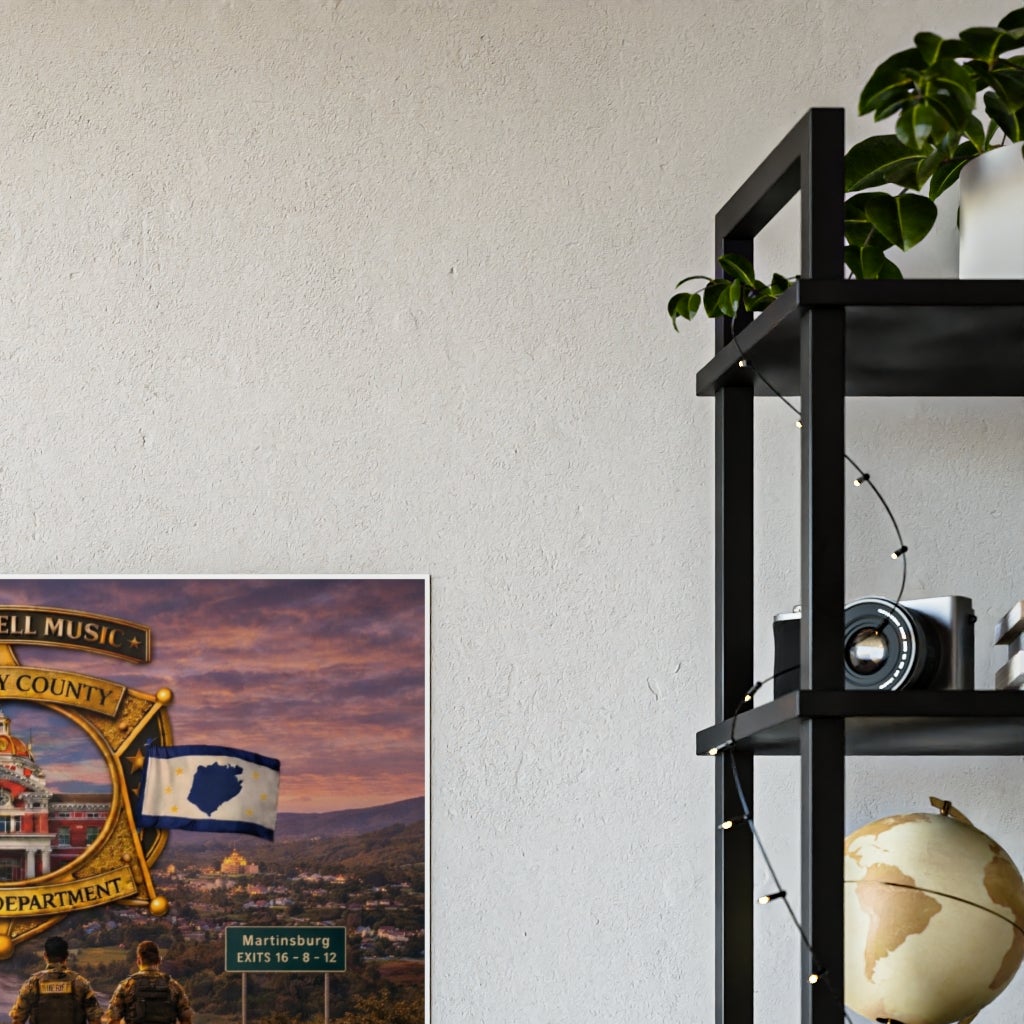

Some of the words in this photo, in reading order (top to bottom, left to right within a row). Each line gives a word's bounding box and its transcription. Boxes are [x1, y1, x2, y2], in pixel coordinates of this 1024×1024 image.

[43, 616, 125, 649] MUSIC
[15, 674, 115, 706] COUNTY
[242, 934, 330, 949] Martinsburg
[237, 952, 271, 963] EXITS
[275, 952, 289, 963] 16
[302, 952, 310, 963] 8
[323, 952, 337, 963] 12
